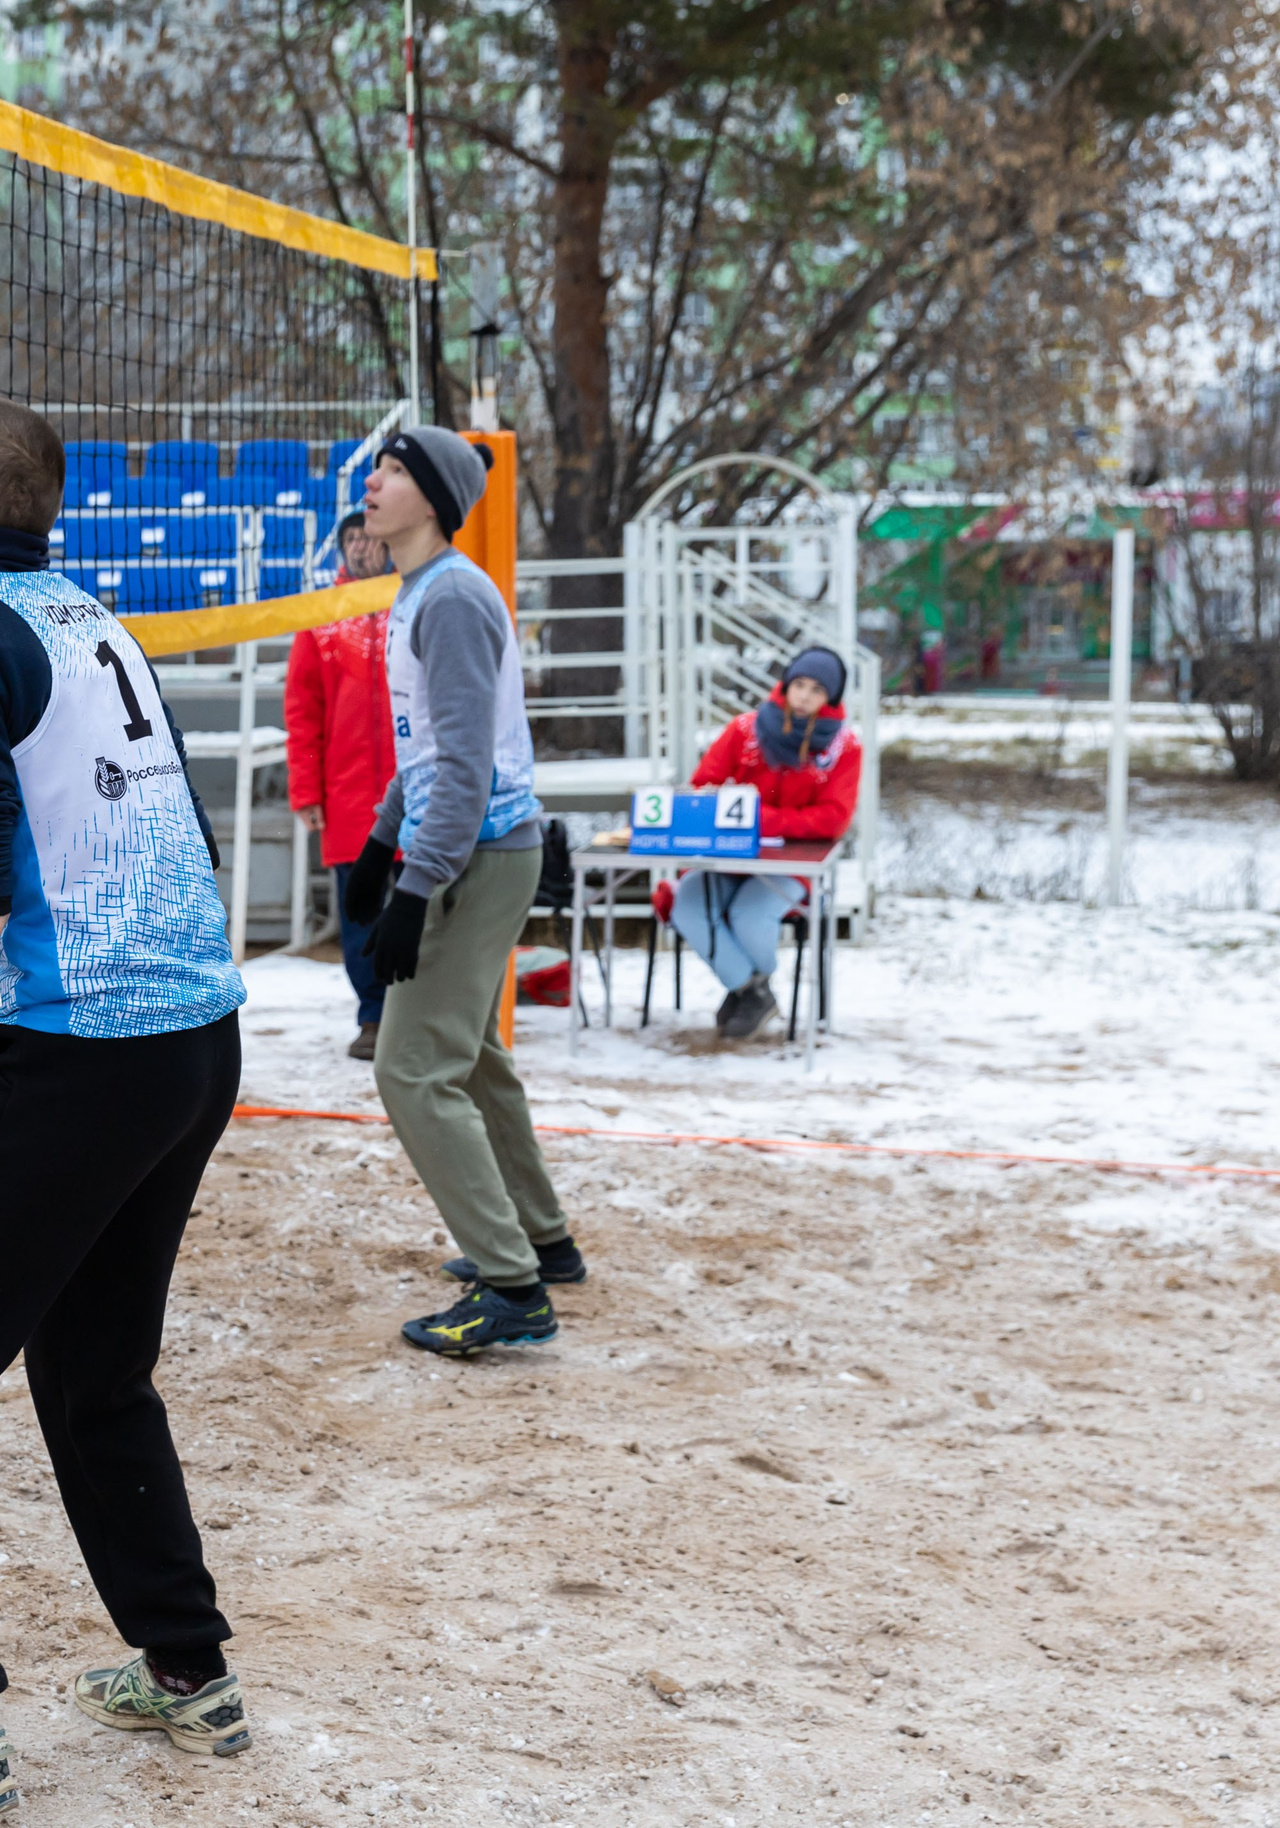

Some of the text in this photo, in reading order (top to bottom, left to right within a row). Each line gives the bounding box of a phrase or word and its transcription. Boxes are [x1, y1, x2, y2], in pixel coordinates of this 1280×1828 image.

[95, 640, 153, 742] 1
[644, 795, 662, 823] 3
[726, 796, 744, 824] 4
